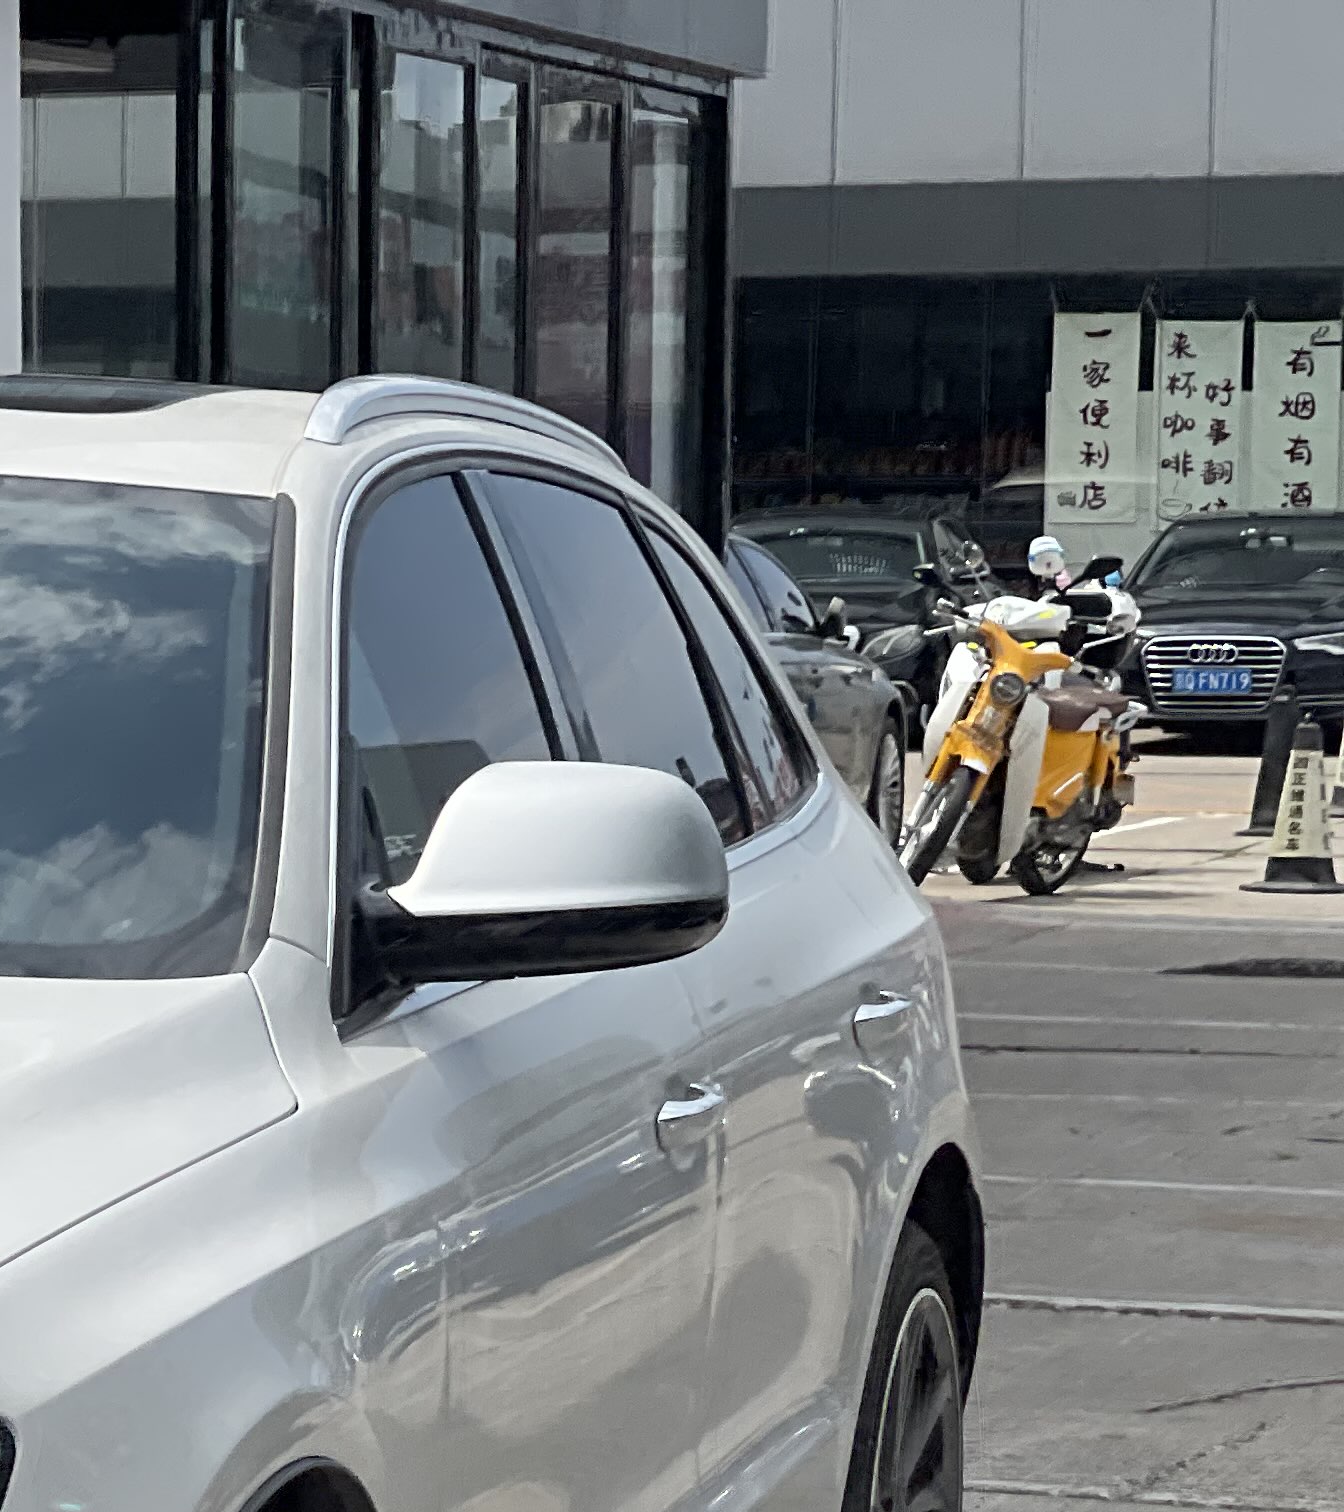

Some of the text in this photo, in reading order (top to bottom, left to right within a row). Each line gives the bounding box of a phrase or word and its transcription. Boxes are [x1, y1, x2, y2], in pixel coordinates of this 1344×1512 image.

[1078, 328, 1112, 510] 一家便利店
[1161, 330, 1197, 478] 来杯咖啡
[1278, 345, 1315, 509] 有烟有酒
